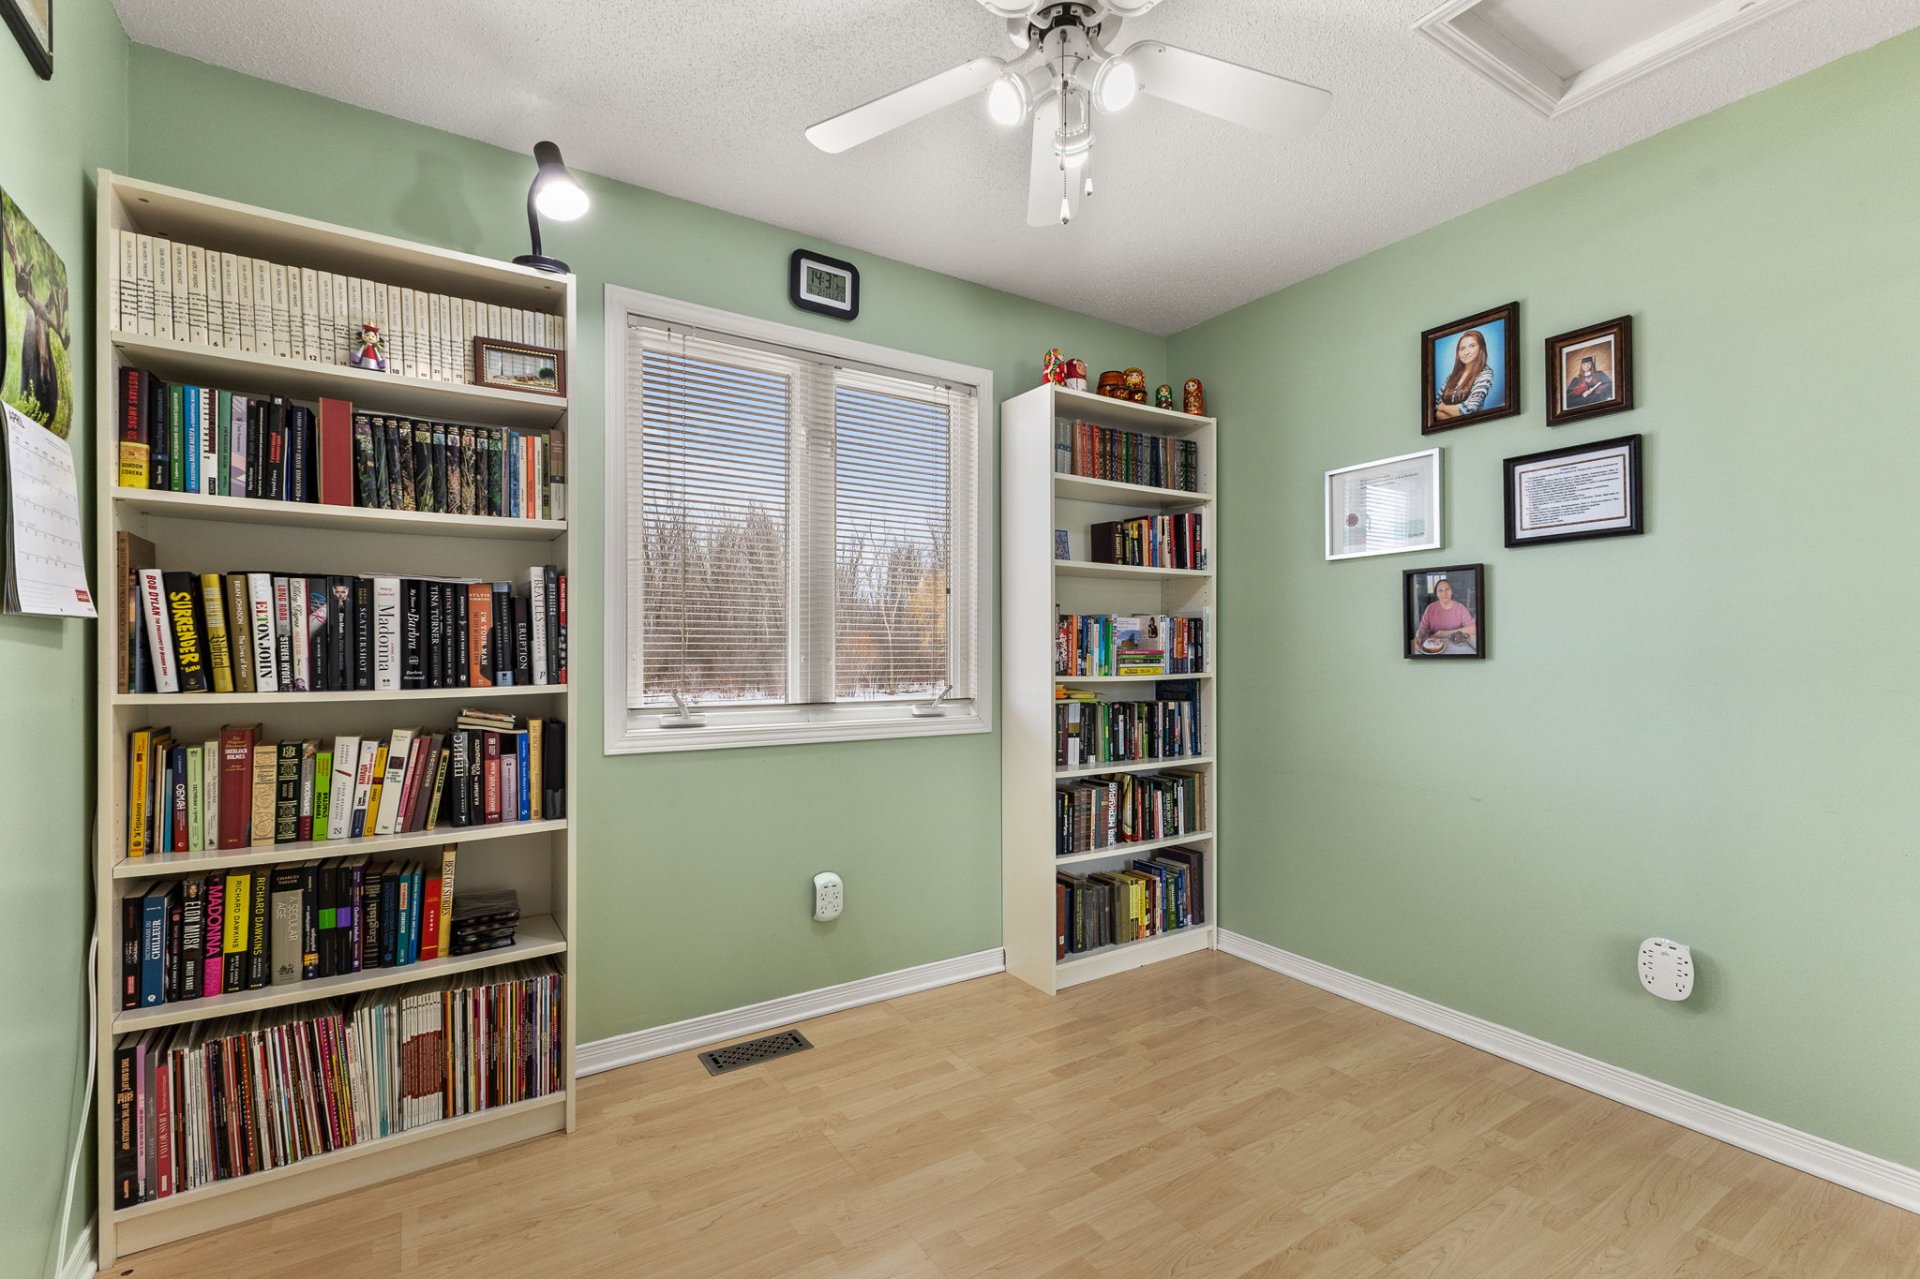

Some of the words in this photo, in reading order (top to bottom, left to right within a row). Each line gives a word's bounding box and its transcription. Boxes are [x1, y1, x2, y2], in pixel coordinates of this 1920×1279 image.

[128, 372, 138, 404] RUSSIANS
[128, 406, 137, 428] AMONG
[128, 431, 137, 440] US
[146, 575, 157, 590] BOB
[291, 581, 301, 602] Miley
[430, 586, 438, 606] TINA
[149, 592, 161, 616] DYLAN
[235, 598, 243, 624] JOHNSON
[292, 605, 303, 628] Cyrus
[310, 592, 327, 625] CHER
[534, 579, 544, 622] BEATLES
[170, 592, 199, 664] SURRENDER
[256, 601, 269, 641] ELTON
[407, 613, 419, 649] Barbra
[431, 609, 439, 644] TURNER
[209, 634, 230, 668] Biblical
[280, 637, 289, 661] STEVEN
[378, 605, 395, 671] Madonna
[518, 623, 527, 669] ERUPTION
[258, 643, 272, 678] JOHN
[282, 662, 291, 684] HYDEN
[424, 750, 437, 787] ФИЛОСОФИЯ
[454, 734, 464, 777] ПЕНИС
[359, 764, 368, 784] КАНАДА
[176, 783, 186, 810] ОБМАН
[1108, 783, 1116, 827] МЕРКУРИЯ
[134, 803, 142, 832] Германия
[1108, 828, 1116, 846] ЭРА
[443, 877, 453, 889] CAT
[444, 861, 454, 876] BEST
[234, 881, 242, 913] RICHARD
[255, 877, 265, 914] RICHARD
[276, 902, 286, 919] AGE
[441, 889, 452, 916] STORIES
[184, 901, 201, 923] ELON
[206, 885, 223, 957] MADONNA
[289, 904, 298, 942] SECULAR
[367, 903, 379, 943] English
[152, 919, 161, 959] CHILLEUR
[183, 925, 200, 950] MUSK
[232, 916, 240, 948] DAWKINS
[253, 917, 264, 955] DAWKINS
[159, 1133, 168, 1159] TAYLOR
